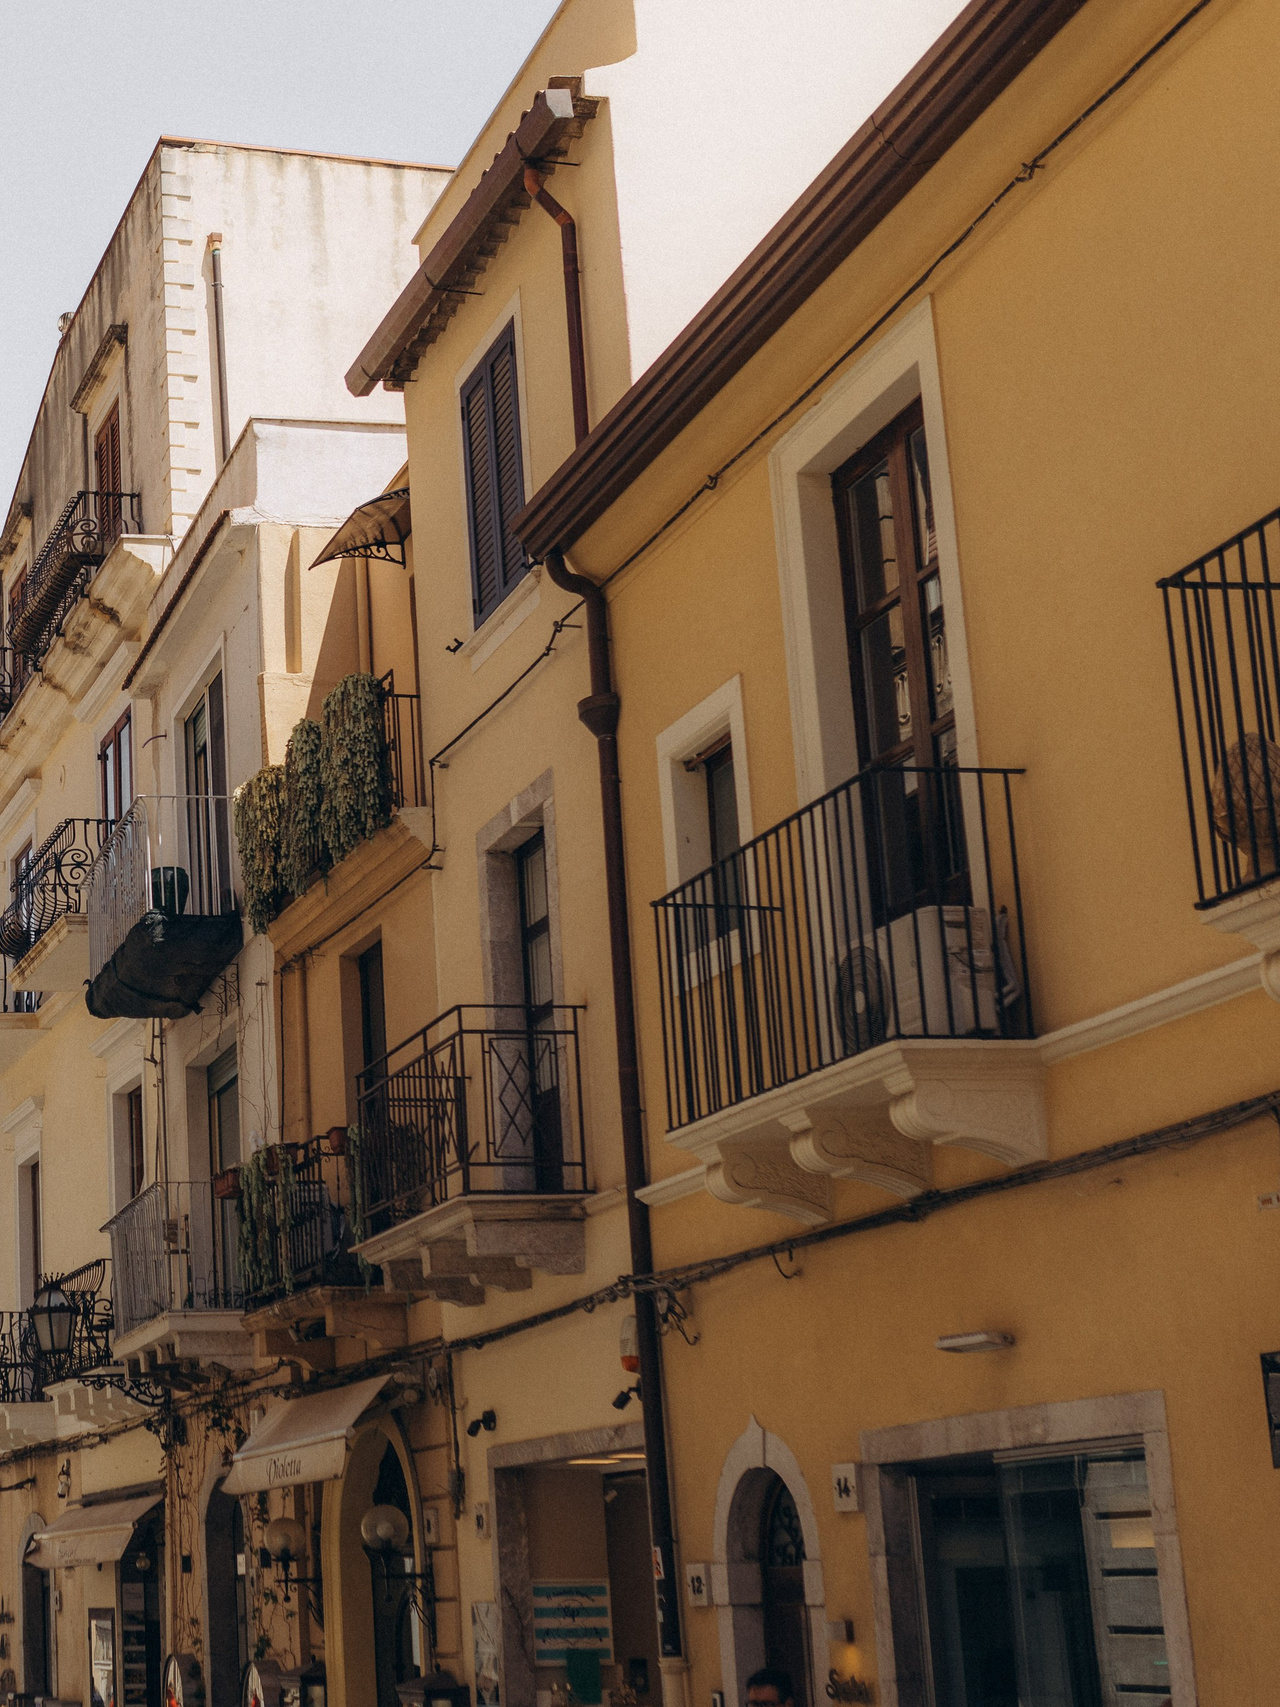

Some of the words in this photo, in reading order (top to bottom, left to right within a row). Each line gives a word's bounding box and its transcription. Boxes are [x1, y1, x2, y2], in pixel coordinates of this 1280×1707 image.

[266, 1454, 302, 1486] Violetta
[836, 1477, 851, 1499] 14
[690, 1575, 703, 1596] 12
